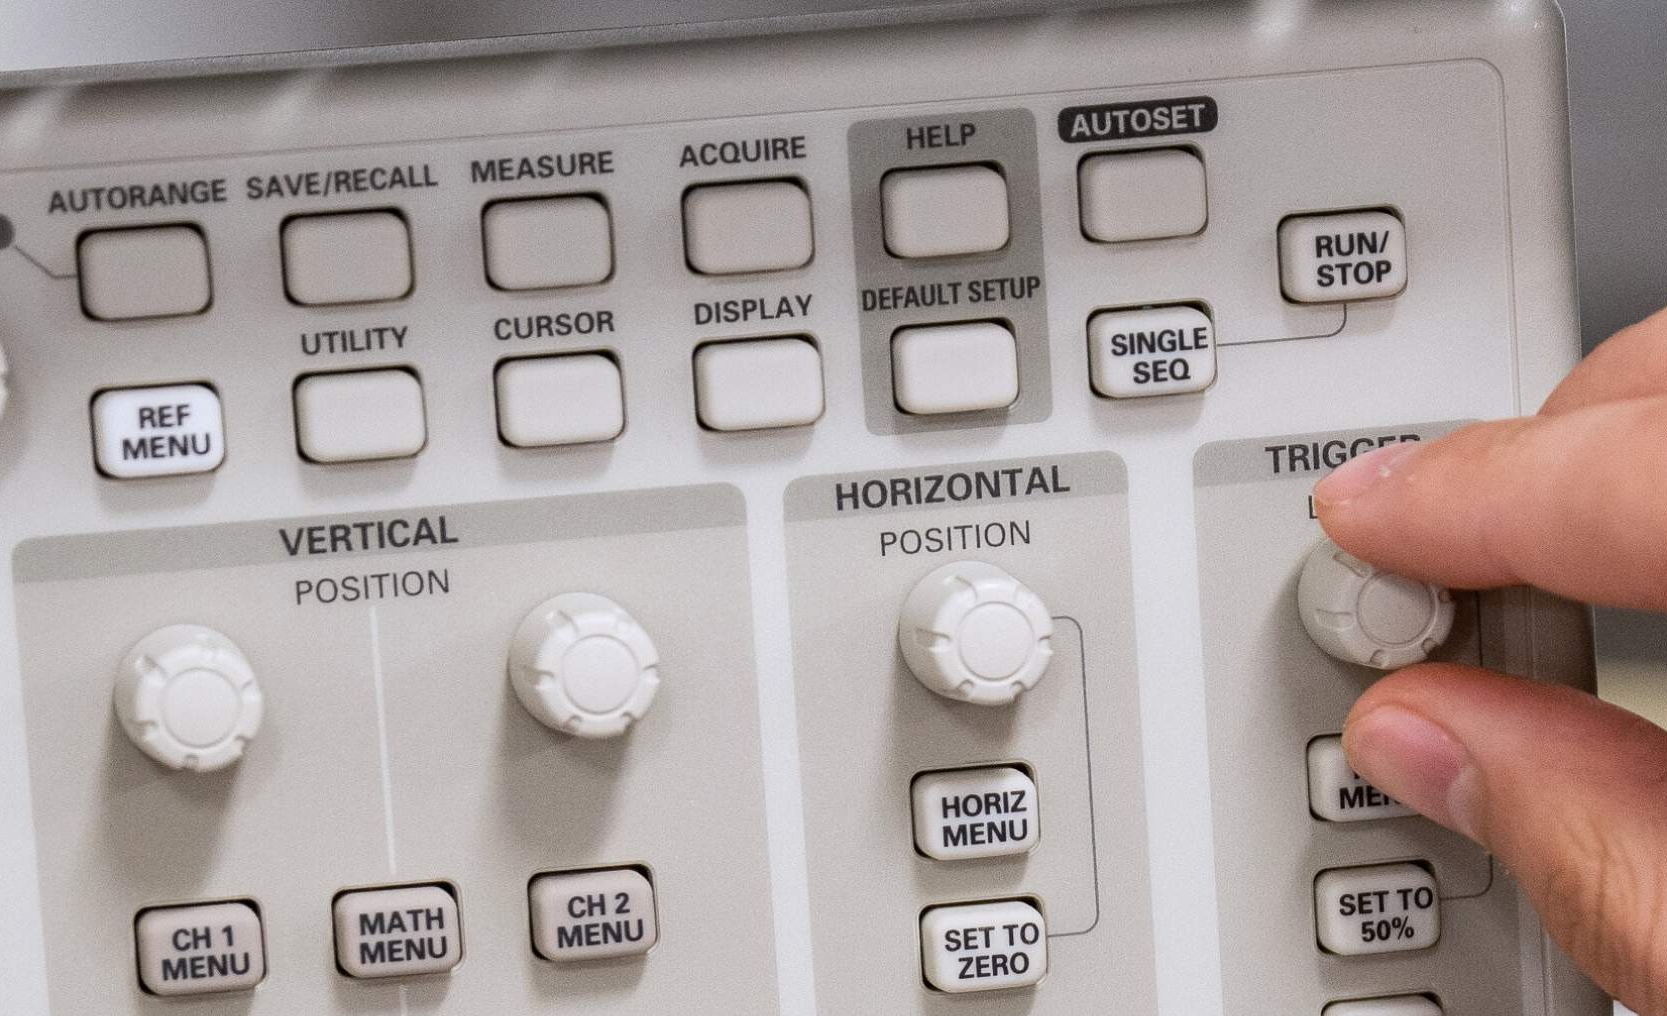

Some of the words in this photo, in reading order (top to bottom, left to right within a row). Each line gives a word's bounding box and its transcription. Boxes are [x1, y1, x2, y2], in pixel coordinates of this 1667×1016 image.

[1069, 103, 1206, 138] AUTOSET
[679, 136, 807, 168] ACQUIRE
[905, 122, 977, 151] HELP
[245, 163, 439, 201] SAVE/RECALL
[471, 150, 615, 184] MEASURE
[48, 178, 228, 214] AUTORANGE
[1315, 230, 1390, 260] RUN/
[1315, 258, 1393, 288] STOP
[861, 281, 962, 313] DEFAULT
[967, 275, 1042, 306] SETUP
[493, 309, 615, 342] CURSOR
[693, 294, 813, 328] DISPLAY
[300, 325, 408, 356] UTILITY
[1110, 325, 1209, 357] SINGLE
[1132, 357, 1192, 386] SEQ
[138, 404, 192, 430] REF
[121, 432, 212, 462] MENU
[835, 465, 1071, 511] HORIZONTAL
[279, 514, 460, 558] VERTICAL
[879, 519, 1032, 557] POSITION
[295, 568, 451, 606] POSITION
[940, 790, 1028, 820] HORIZ
[942, 818, 1030, 849] MENU
[567, 894, 607, 920] CH
[614, 891, 631, 916] 2
[1338, 889, 1393, 915] SET
[1396, 886, 1435, 911] TO
[357, 907, 446, 936] MATH
[557, 917, 646, 949] MENU
[944, 925, 999, 952] SET
[1003, 921, 1041, 947] TO
[1360, 917, 1416, 943] 50%
[171, 927, 211, 953] CH
[218, 924, 235, 949] 1
[358, 935, 449, 966] MENU
[161, 951, 252, 981] MENU
[957, 951, 1031, 981] ZERO
